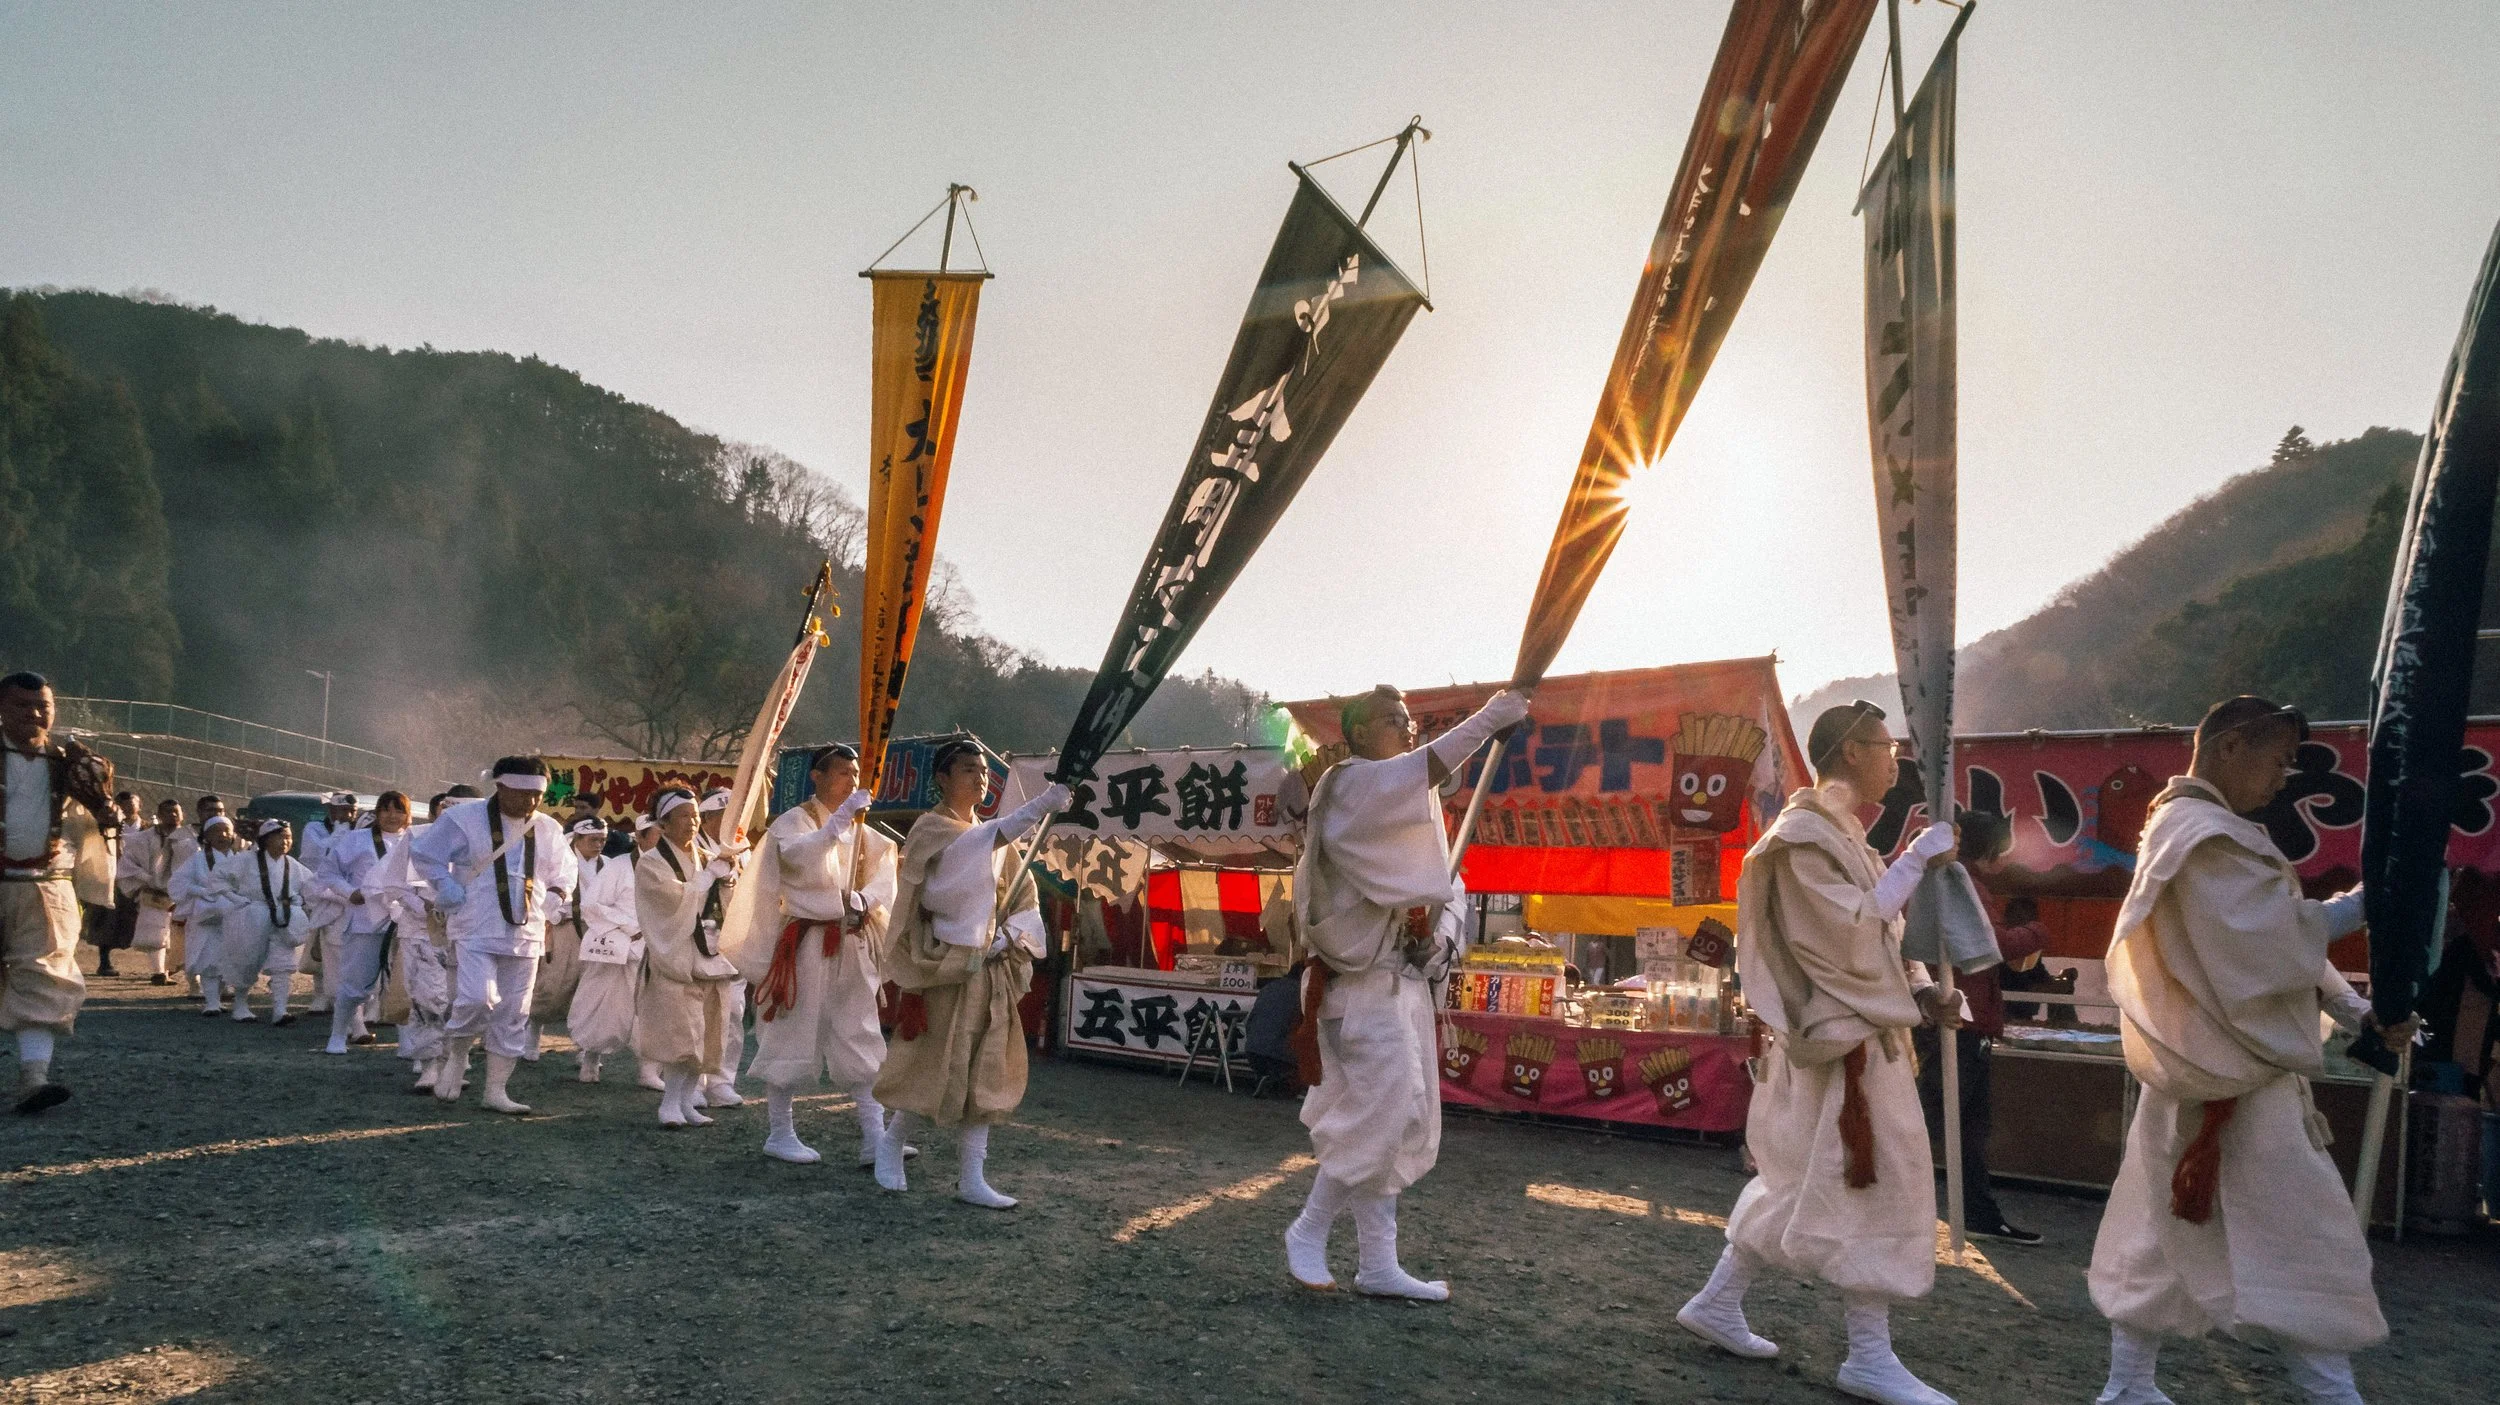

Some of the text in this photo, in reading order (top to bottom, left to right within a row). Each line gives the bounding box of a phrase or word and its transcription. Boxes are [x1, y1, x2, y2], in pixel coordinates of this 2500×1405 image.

[1468, 716, 1665, 793] ポテト
[1043, 760, 1250, 831] 五平餅
[1073, 987, 1246, 1057] 五平餅
